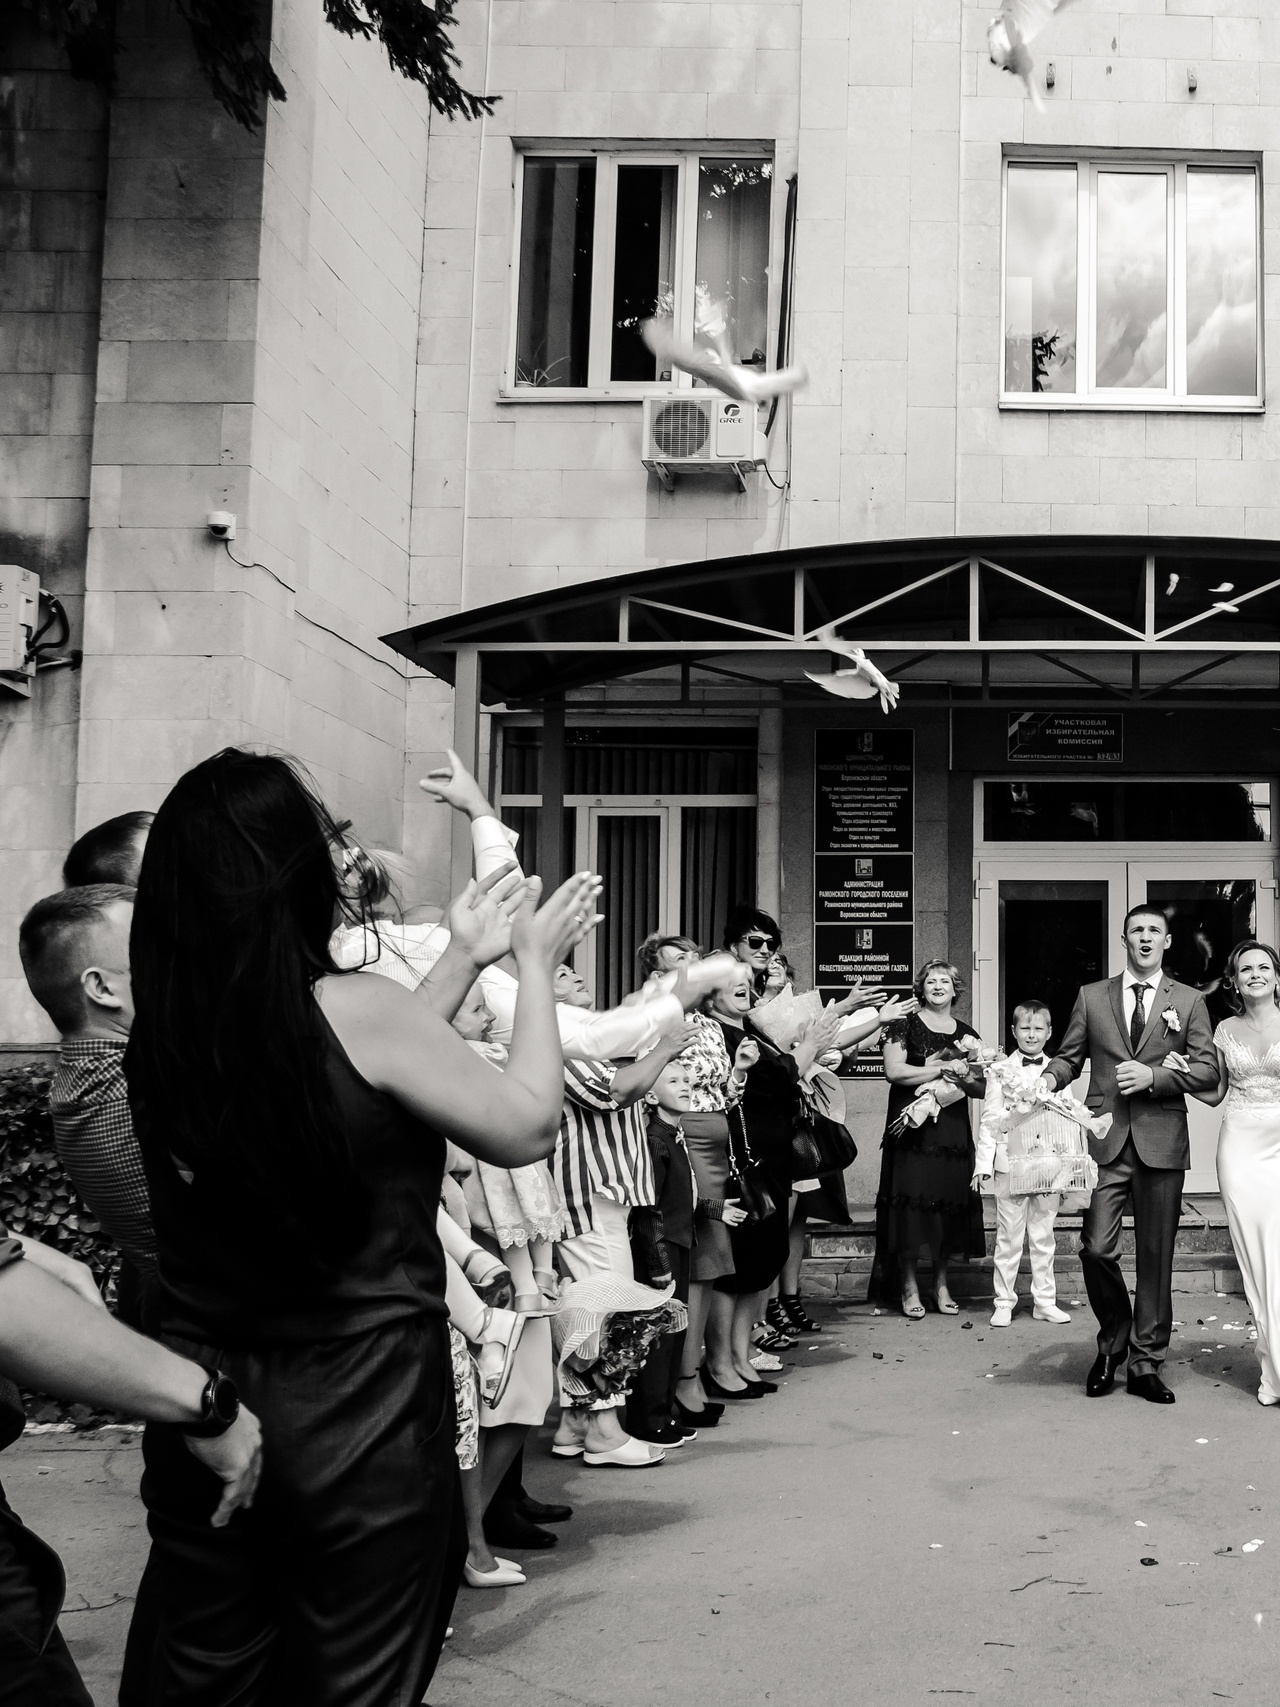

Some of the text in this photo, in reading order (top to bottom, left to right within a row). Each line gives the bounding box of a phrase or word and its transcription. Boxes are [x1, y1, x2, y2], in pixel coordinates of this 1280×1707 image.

[1045, 728, 1115, 736] ИЗБИРАТЕЛЬНАЯ
[844, 880, 884, 888] АДМИНИСТРАЦИЯ
[819, 890, 850, 898] РАМОНСКОГО
[850, 890, 880, 898] ГОРОДСКОГО
[886, 901, 903, 909] района
[840, 910, 887, 919] Воронежской области
[838, 952, 889, 962] РЕДАКЦИЯ РАЙОННОЙ
[819, 963, 909, 972] ОБЩЕСТВЕННО-ПОЛИТИЧЕСКОЙ ГАЗЕТЫ
